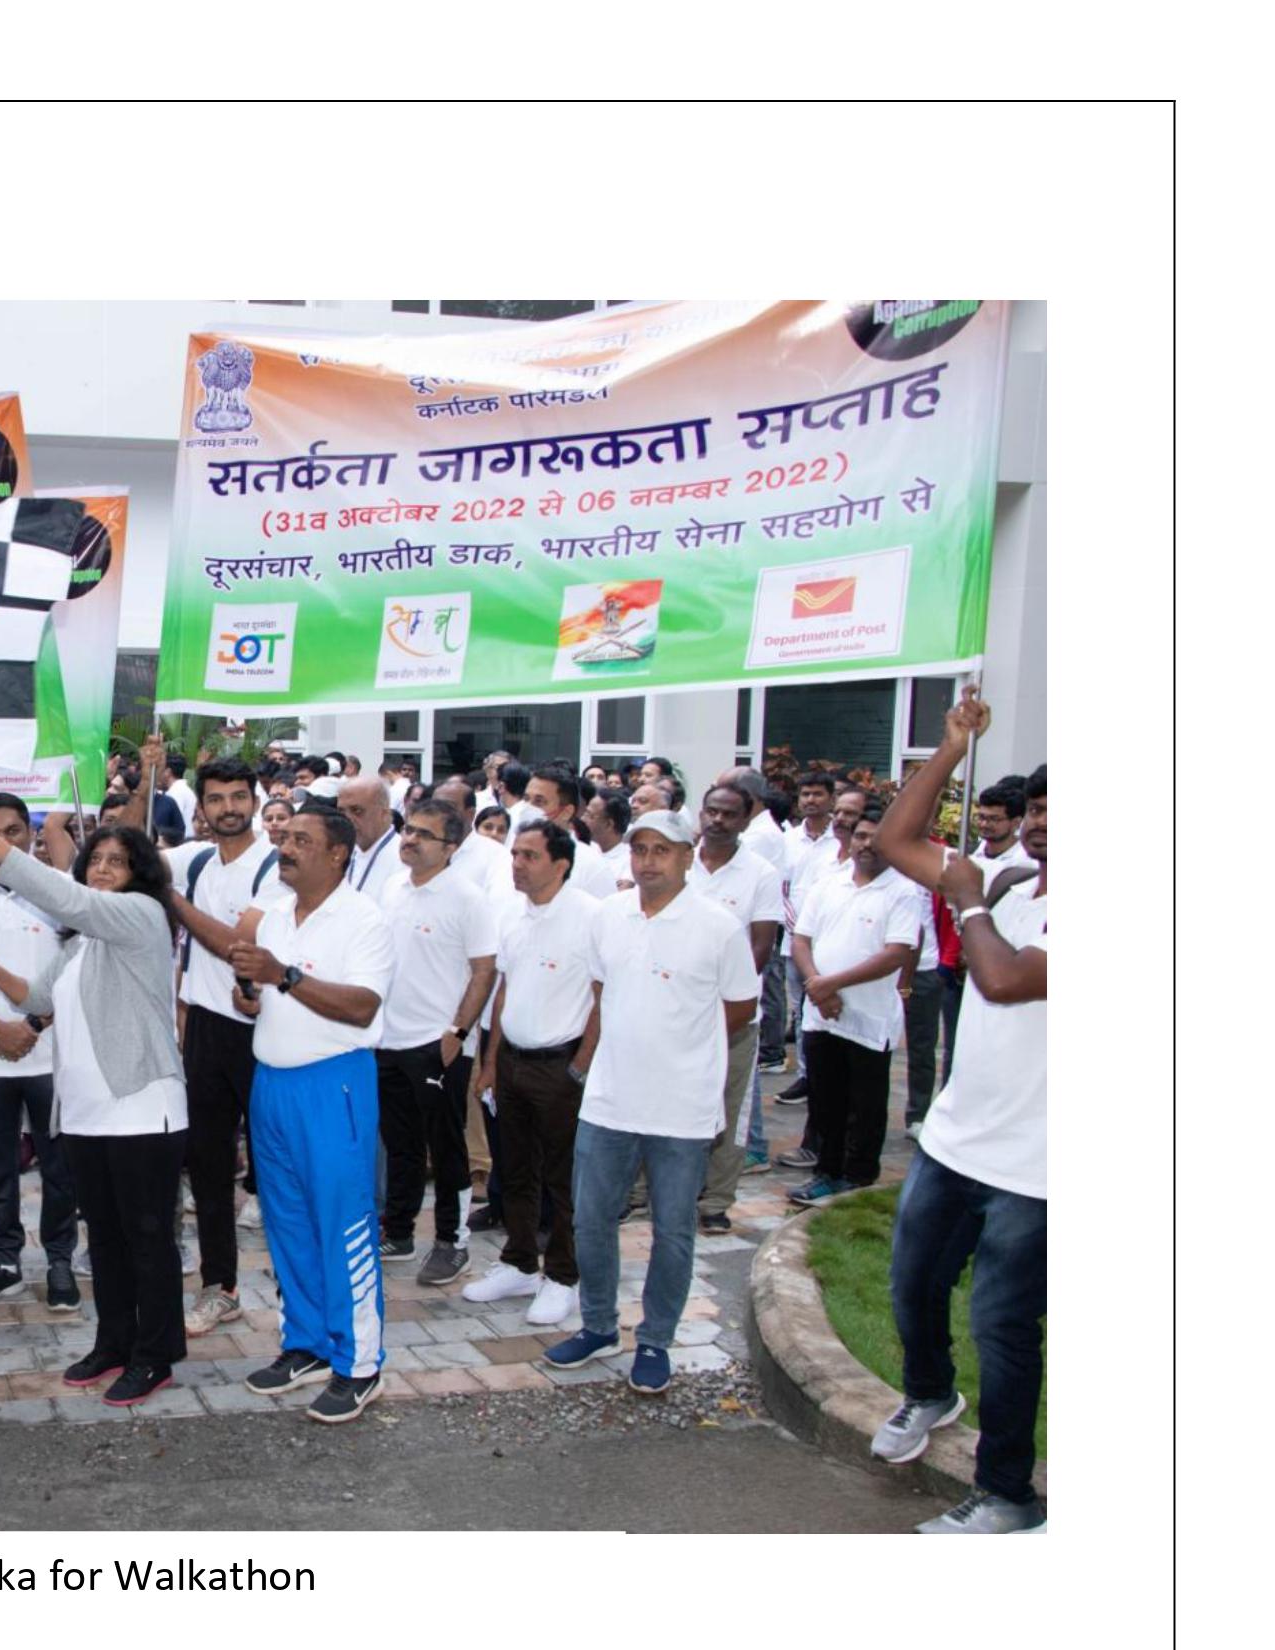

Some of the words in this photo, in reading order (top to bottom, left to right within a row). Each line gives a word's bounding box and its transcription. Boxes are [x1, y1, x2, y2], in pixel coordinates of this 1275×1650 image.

[207, 440, 398, 497] सतर्कता
[418, 417, 713, 484] जागरूकता
[737, 362, 949, 450] सप्ताह
[416, 395, 500, 419] कर्नाटक
[337, 498, 442, 530] अक्टोबर
[451, 496, 526, 524] 2022
[538, 489, 566, 518] से
[577, 490, 617, 515] 06
[629, 477, 733, 508] नवम्बर
[338, 538, 437, 576] भारतीय
[541, 525, 661, 561] भारतीय
[675, 518, 746, 548] सेना
[761, 494, 885, 539] सहयोग
[900, 477, 937, 514] से
[764, 629, 840, 647] Department
[841, 626, 856, 638] of
[856, 623, 887, 636] Post
